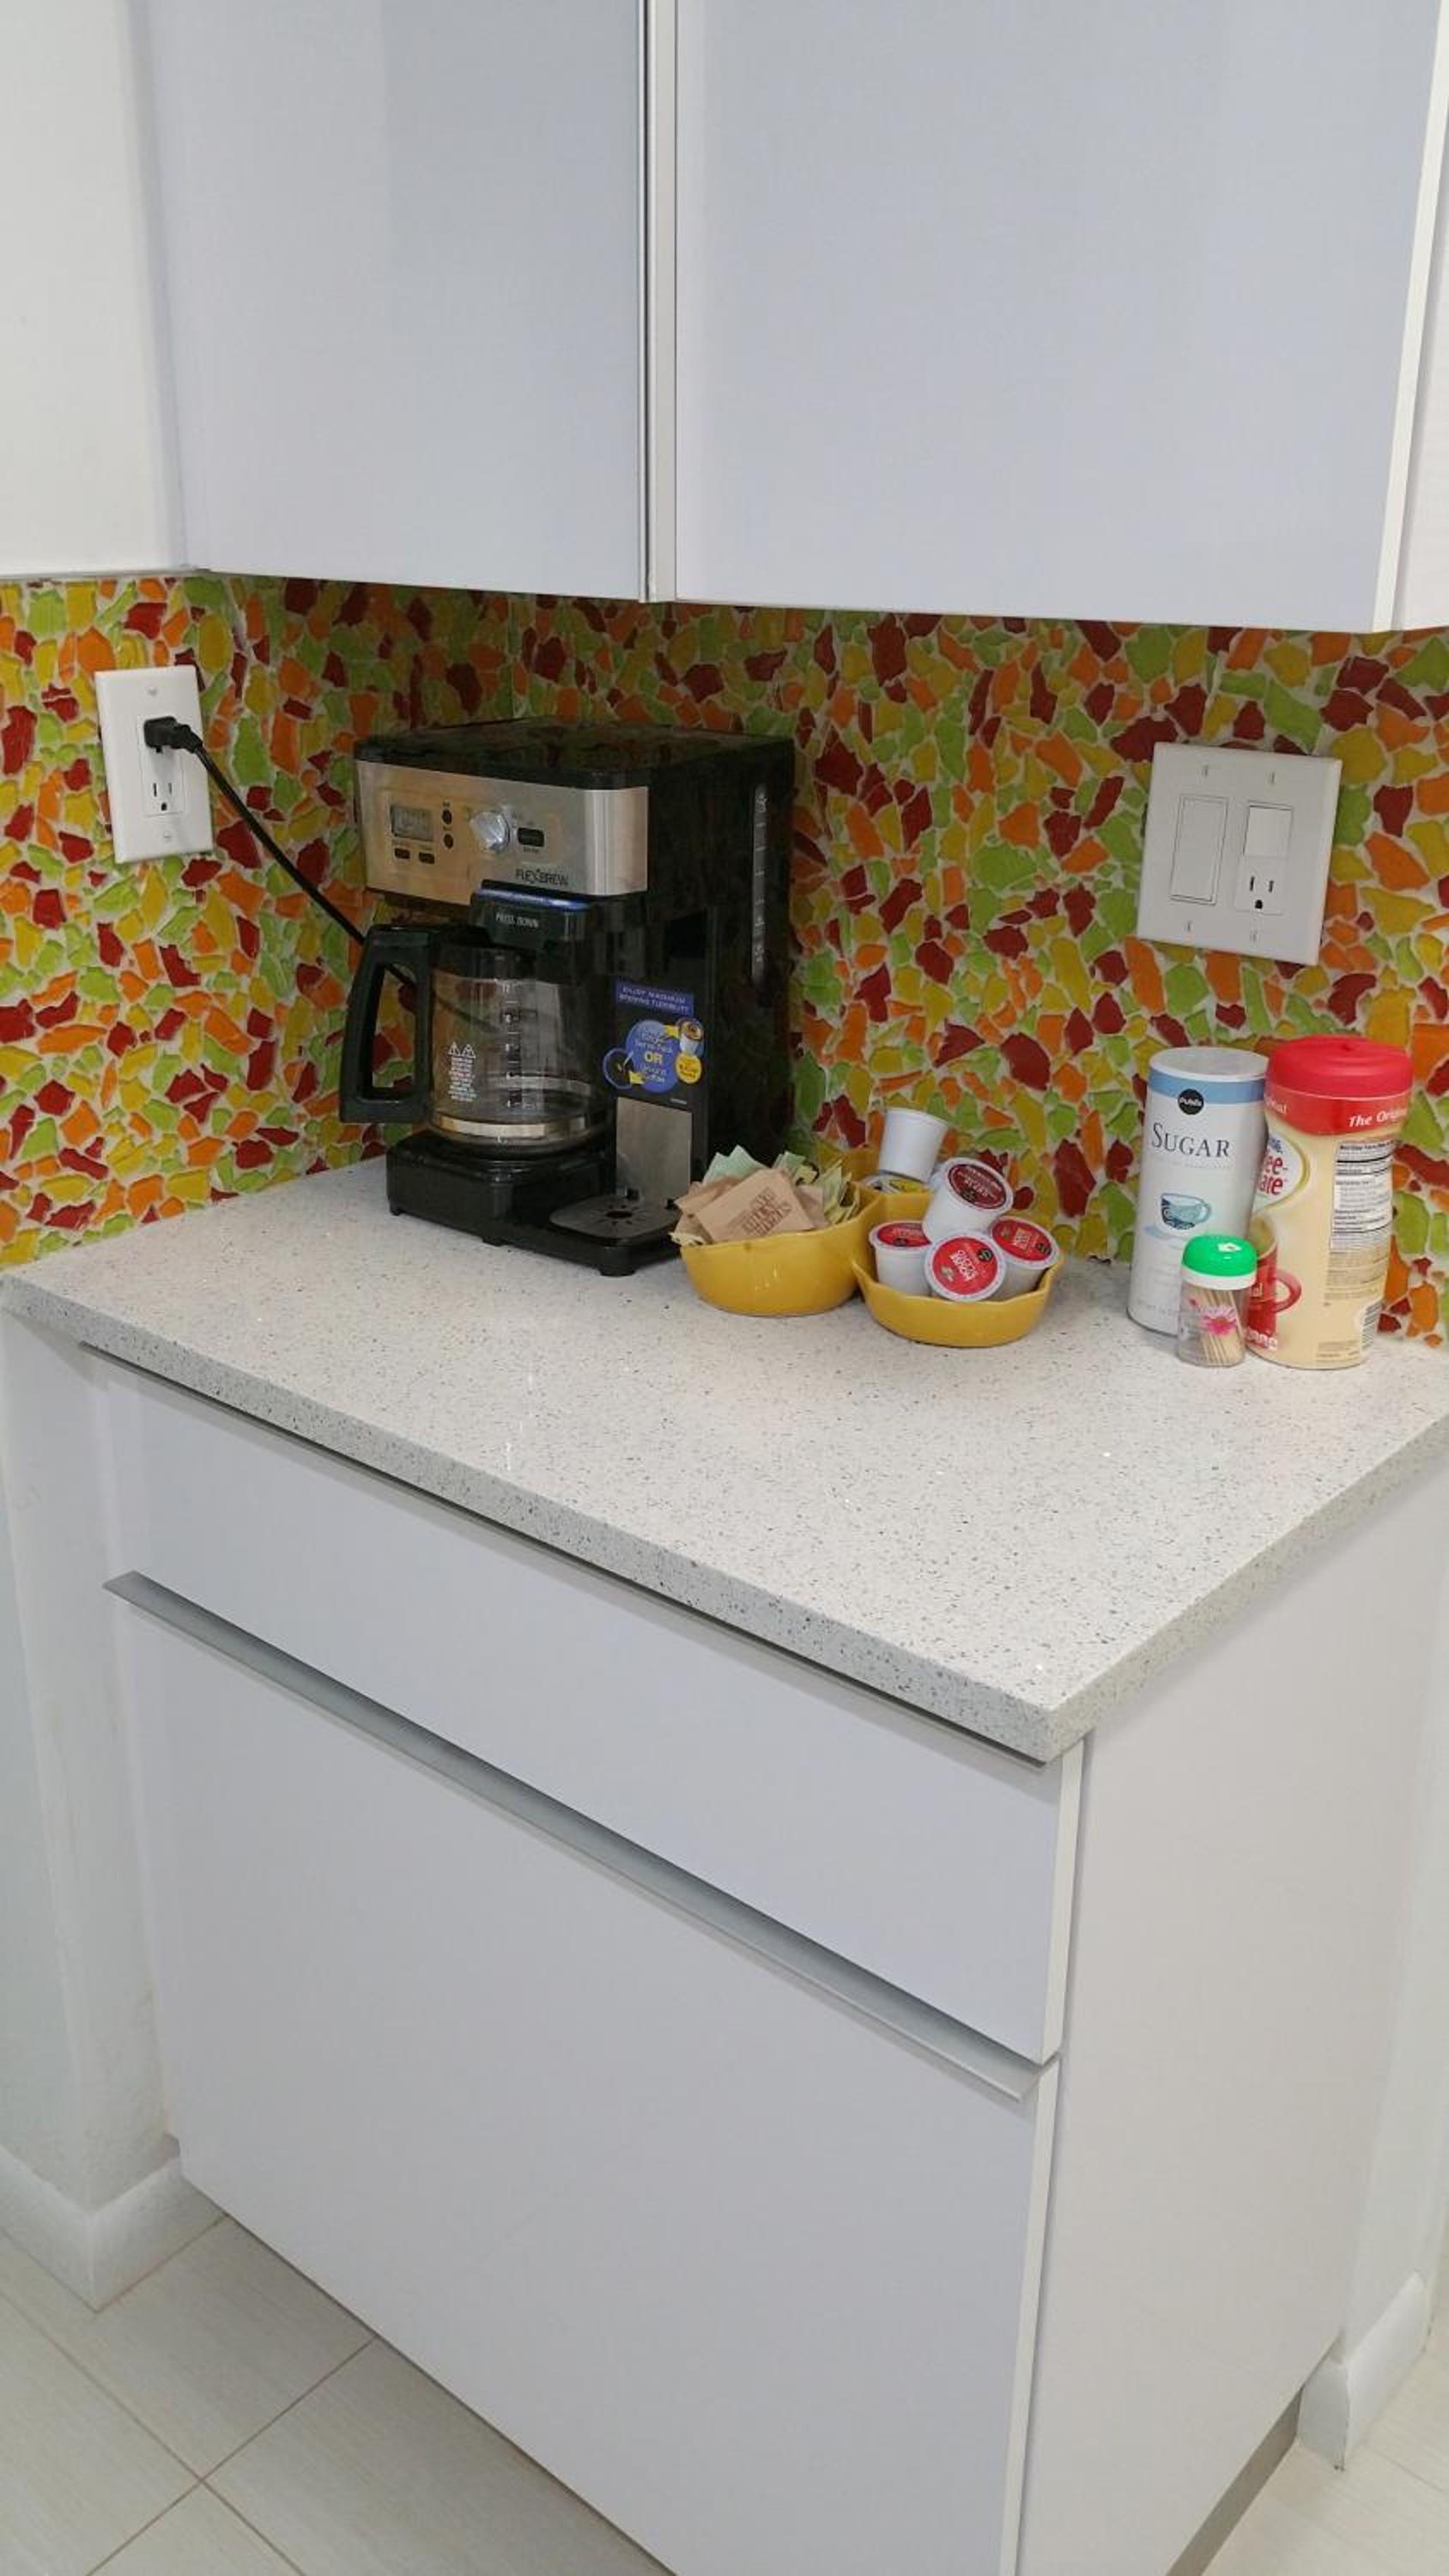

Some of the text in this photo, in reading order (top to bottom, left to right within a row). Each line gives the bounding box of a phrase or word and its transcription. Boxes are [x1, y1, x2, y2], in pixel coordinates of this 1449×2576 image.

[644, 1050, 664, 1066] OR
[1349, 1115, 1373, 1127] The
[1152, 1121, 1230, 1157] SUGAR
